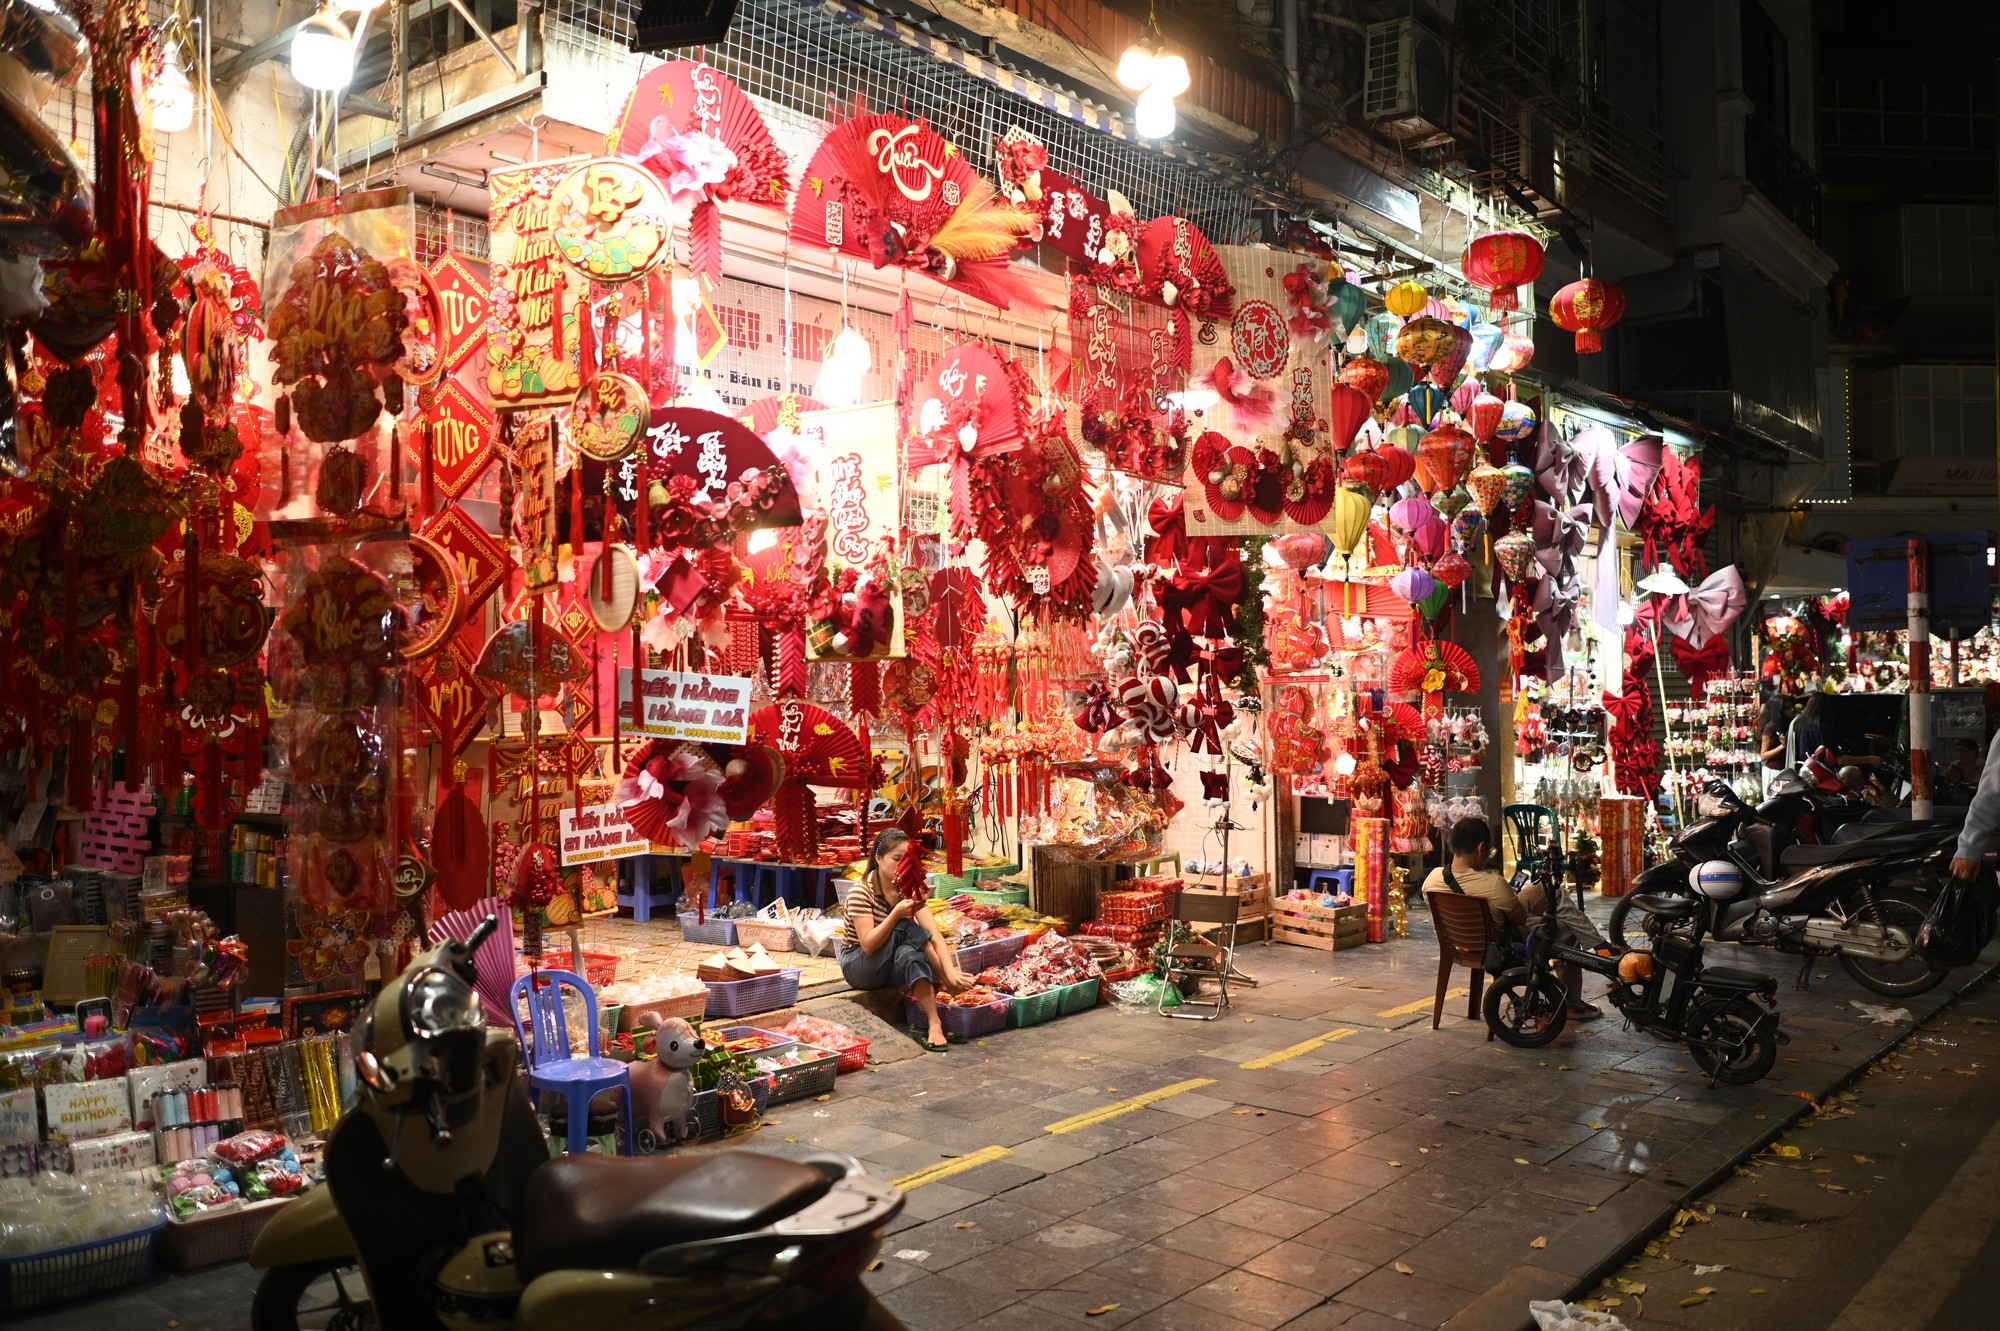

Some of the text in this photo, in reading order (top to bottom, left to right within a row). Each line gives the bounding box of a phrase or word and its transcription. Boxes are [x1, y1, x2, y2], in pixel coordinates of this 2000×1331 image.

[867, 124, 944, 202] Xuân
[588, 165, 645, 222] Lộc
[511, 202, 549, 236] Chú
[519, 297, 554, 330] Mớ
[1087, 305, 1117, 390] Tết Bình An
[729, 370, 762, 388] Bán
[646, 421, 691, 457] Tết
[696, 431, 726, 460] Tết
[632, 677, 740, 703] IẾN HẰNG
[648, 701, 707, 724] HÀNG
[711, 708, 745, 728] MÃ
[620, 721, 676, 736] 09598833
[568, 808, 628, 831] TIẾN HẰ
[563, 836, 581, 851] 21
[584, 829, 622, 850] HÀNG
[61, 1105, 118, 1123] BIRTHDAY
[70, 1094, 109, 1109] HAPPY
